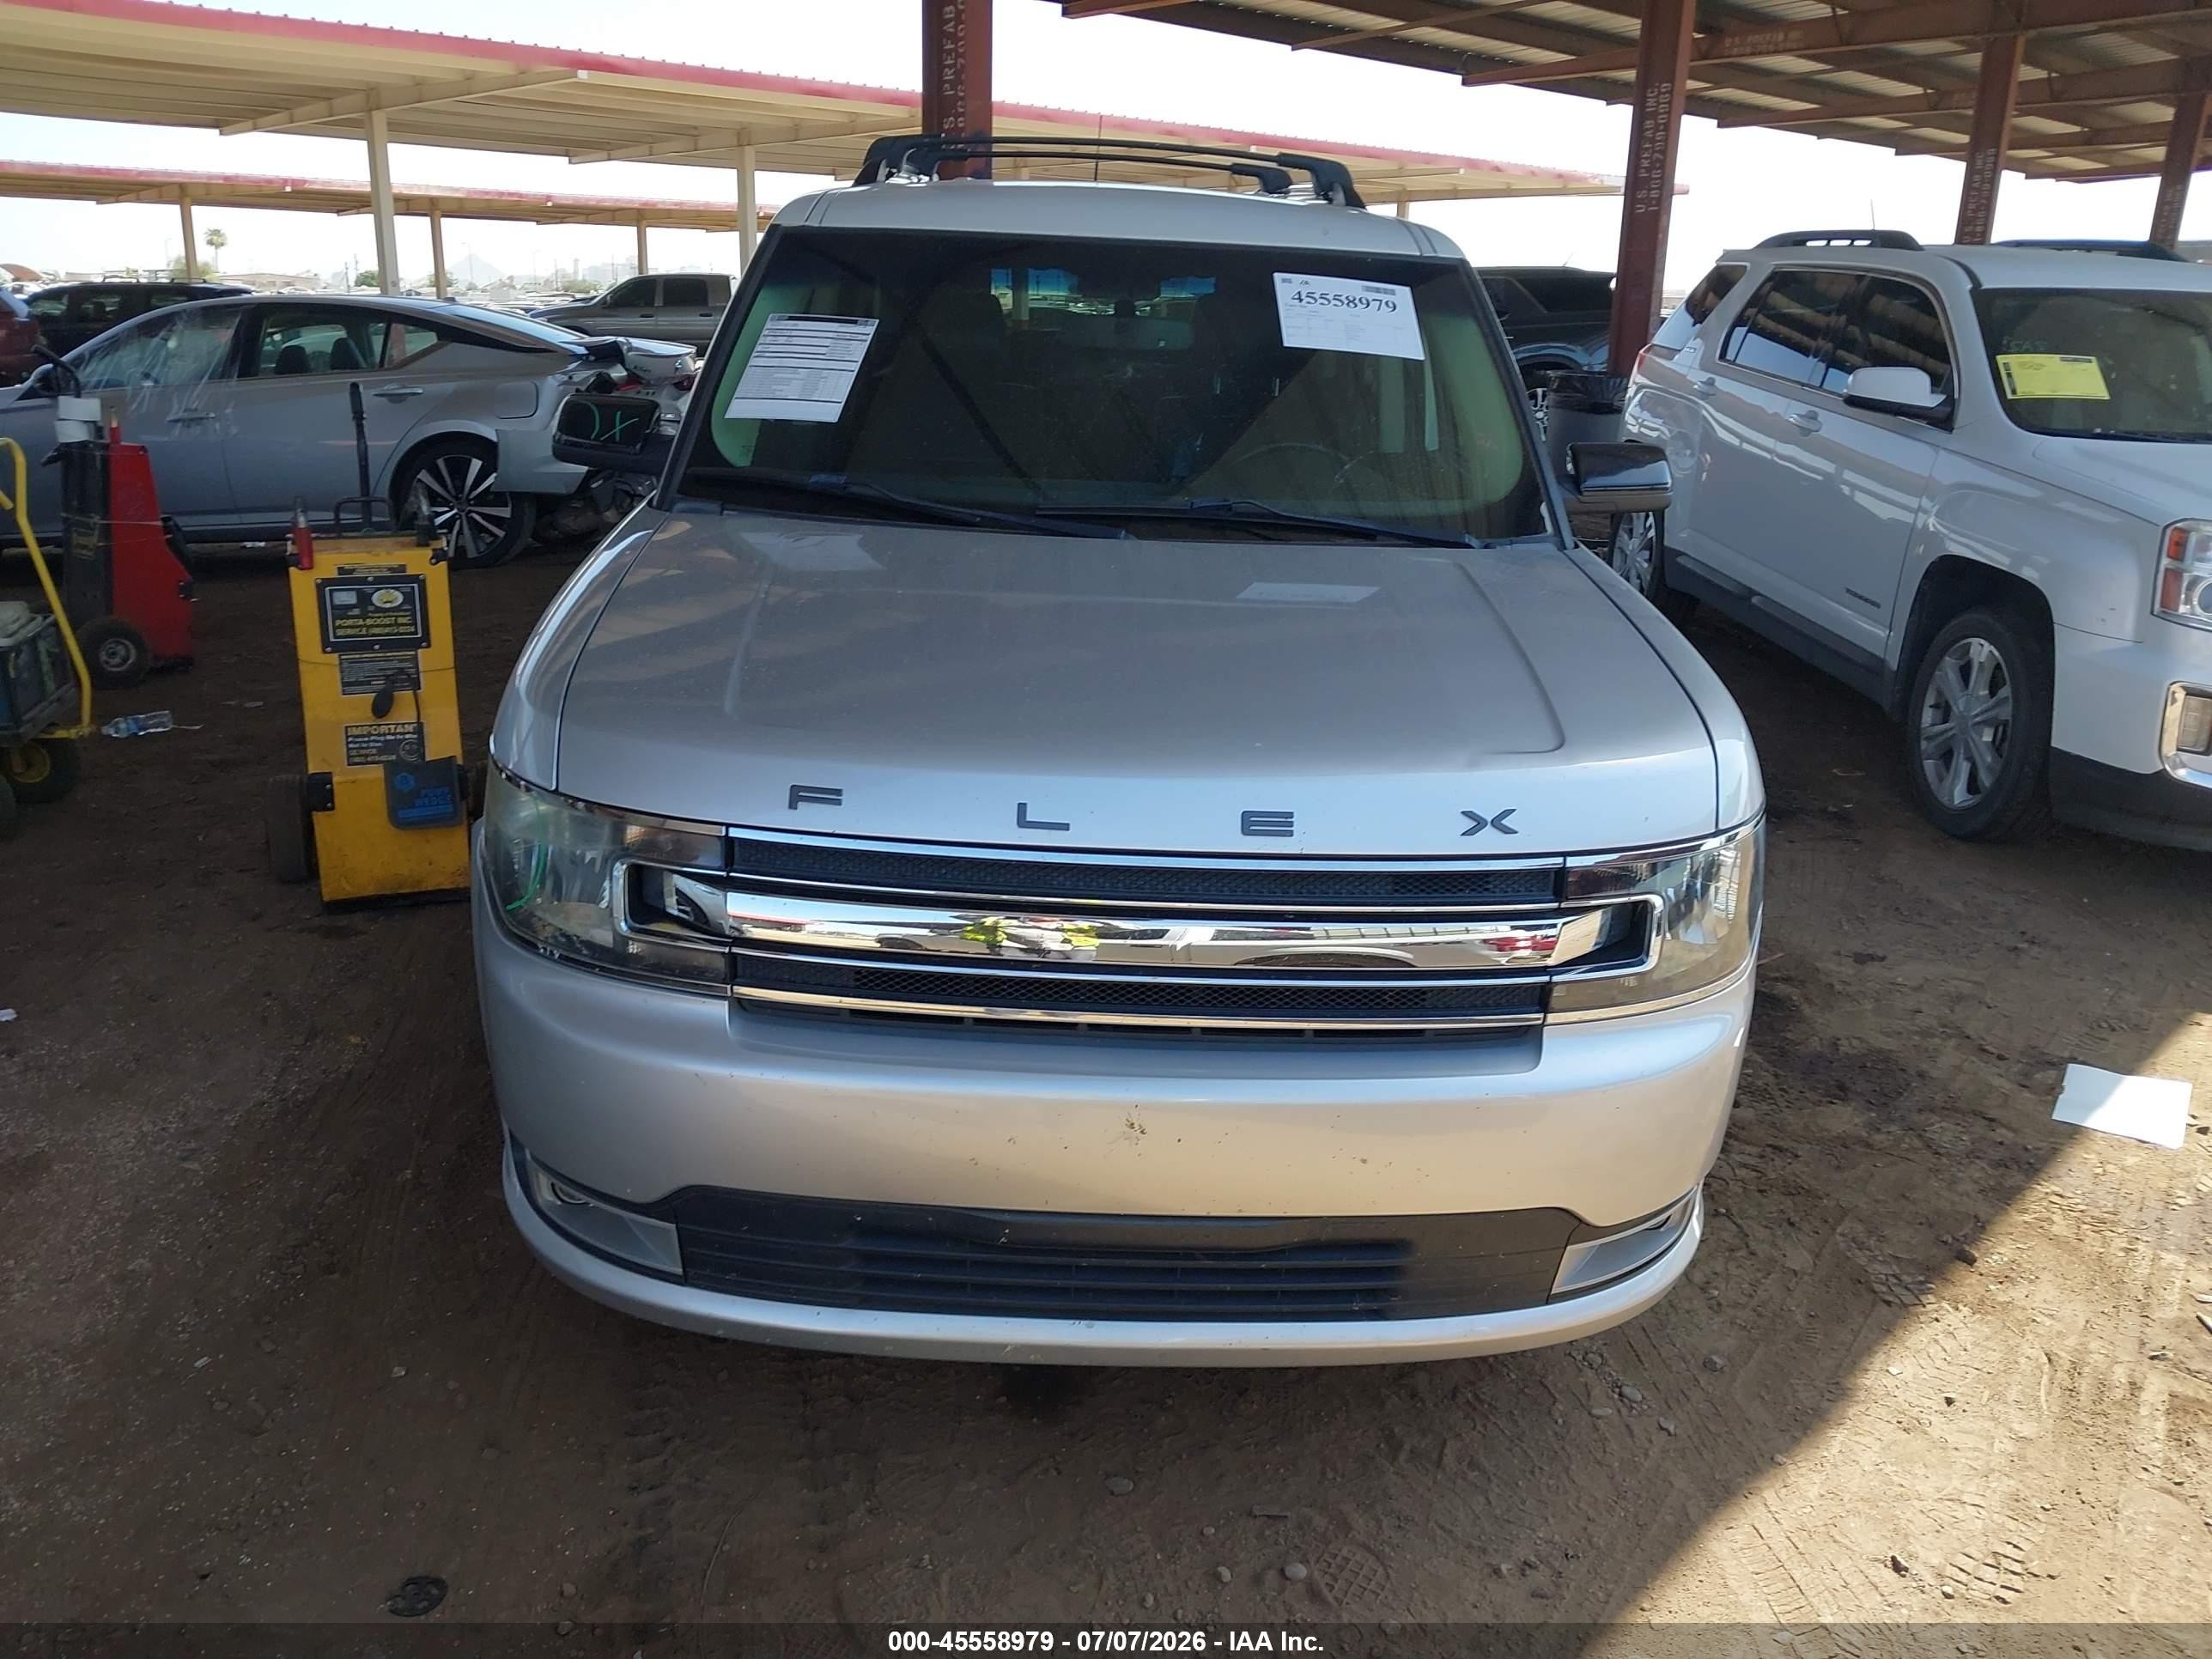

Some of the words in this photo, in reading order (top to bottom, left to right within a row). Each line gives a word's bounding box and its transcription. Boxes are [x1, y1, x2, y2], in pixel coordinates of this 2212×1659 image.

[1645, 82, 1661, 112] INC.
[1638, 119, 1656, 178] PREFAB
[1291, 289, 1397, 313] 45558979
[788, 784, 1518, 836] FLEX
